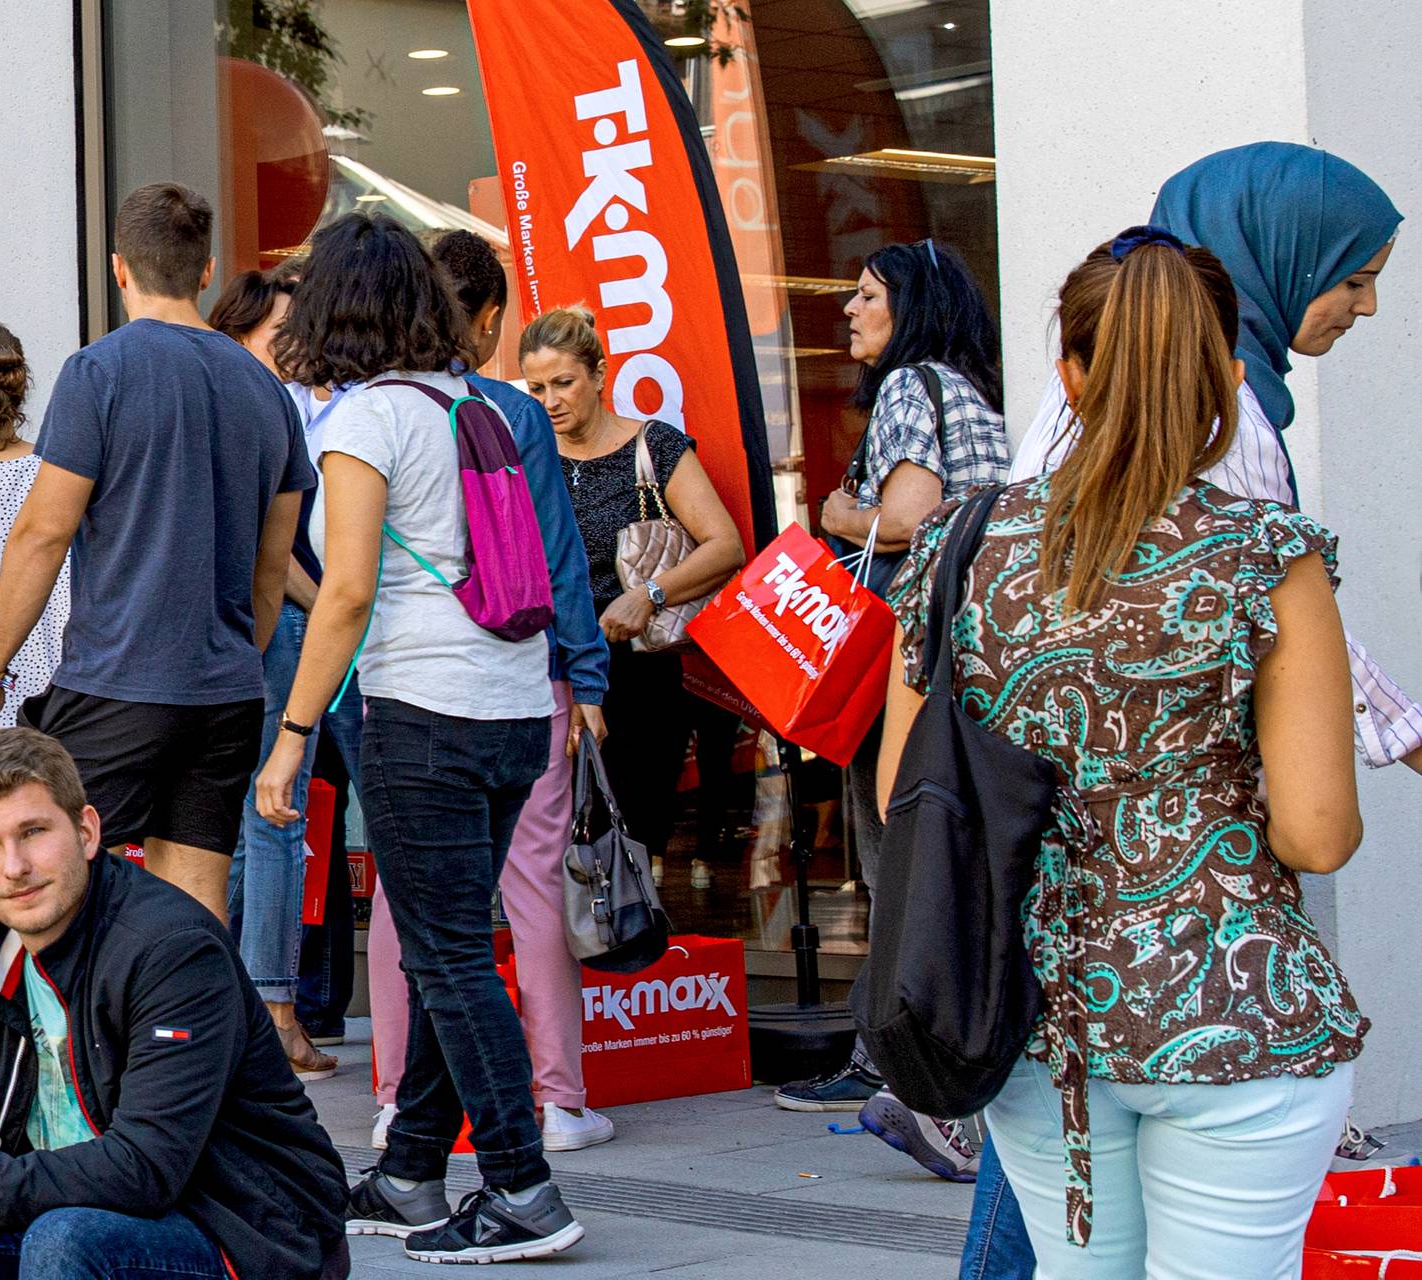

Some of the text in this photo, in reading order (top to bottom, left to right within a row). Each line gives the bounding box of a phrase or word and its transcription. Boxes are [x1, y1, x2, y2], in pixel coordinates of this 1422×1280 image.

[512, 161, 541, 317] Große Marken imm
[604, 1039, 632, 1051] Marken
[633, 1036, 657, 1047] immer
[658, 1033, 670, 1044] bis
[671, 1033, 680, 1042] zu
[681, 1030, 691, 1040] 60
[692, 1029, 700, 1039] %
